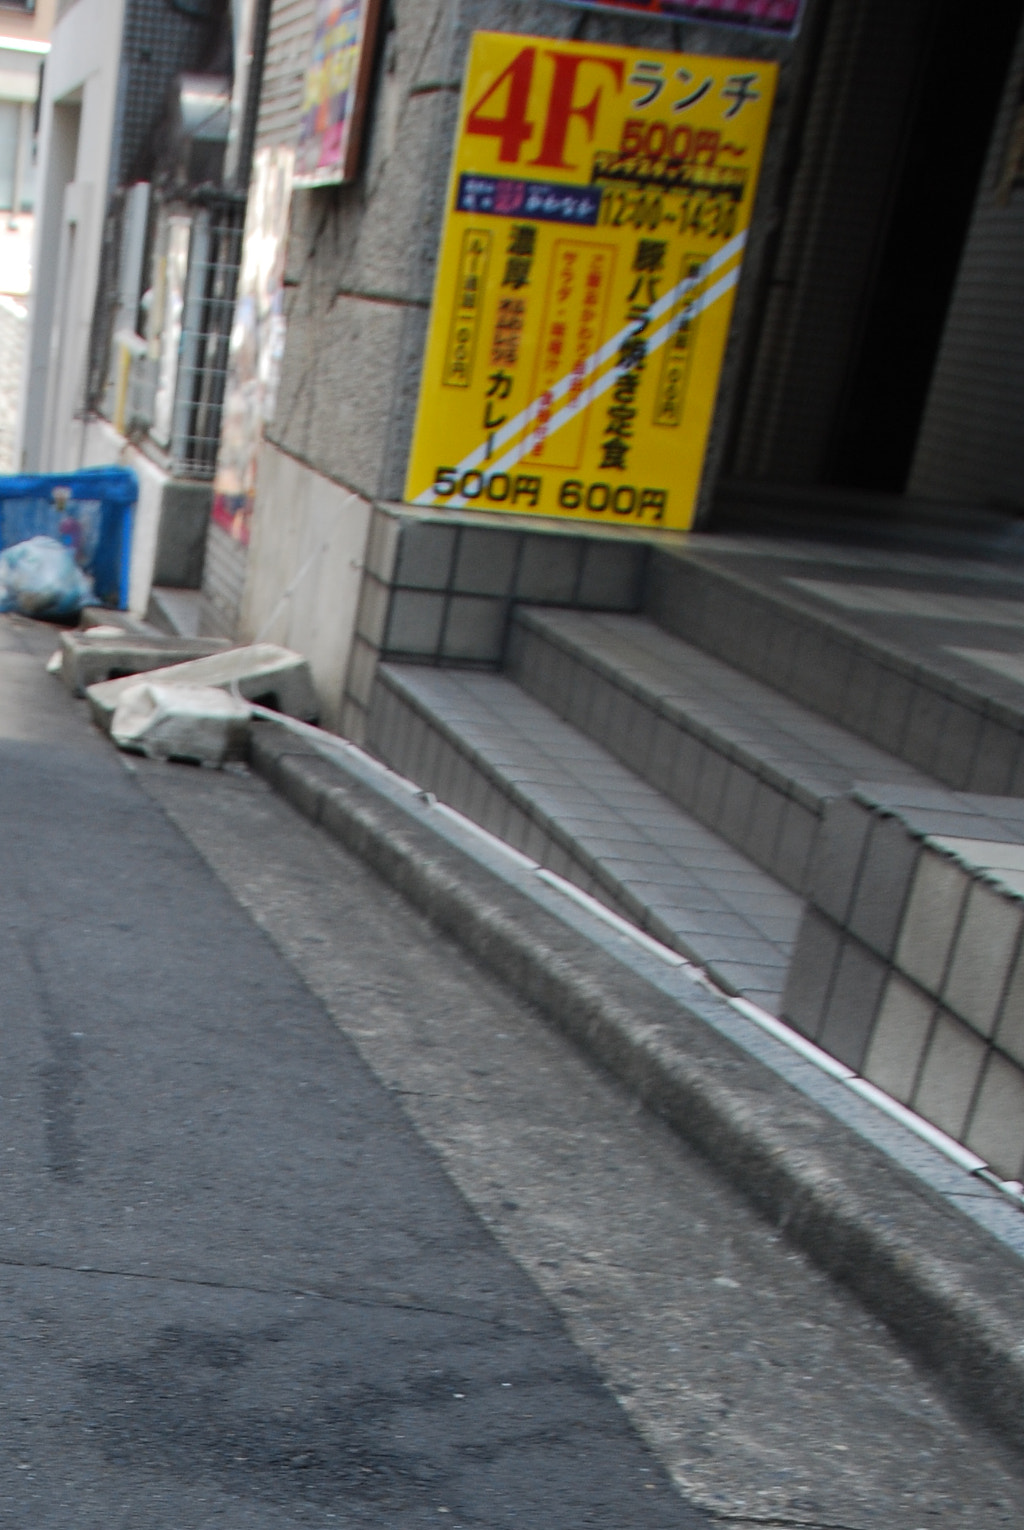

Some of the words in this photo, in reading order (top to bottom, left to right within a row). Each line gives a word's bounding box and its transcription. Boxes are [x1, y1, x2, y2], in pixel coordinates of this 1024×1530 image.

[466, 46, 624, 170] 4F
[628, 61, 762, 119] ランチ
[597, 238, 667, 472] 豚バラ焼き定食
[482, 370, 514, 460] カレー
[433, 466, 541, 508] 500円
[559, 479, 668, 521] 600円
